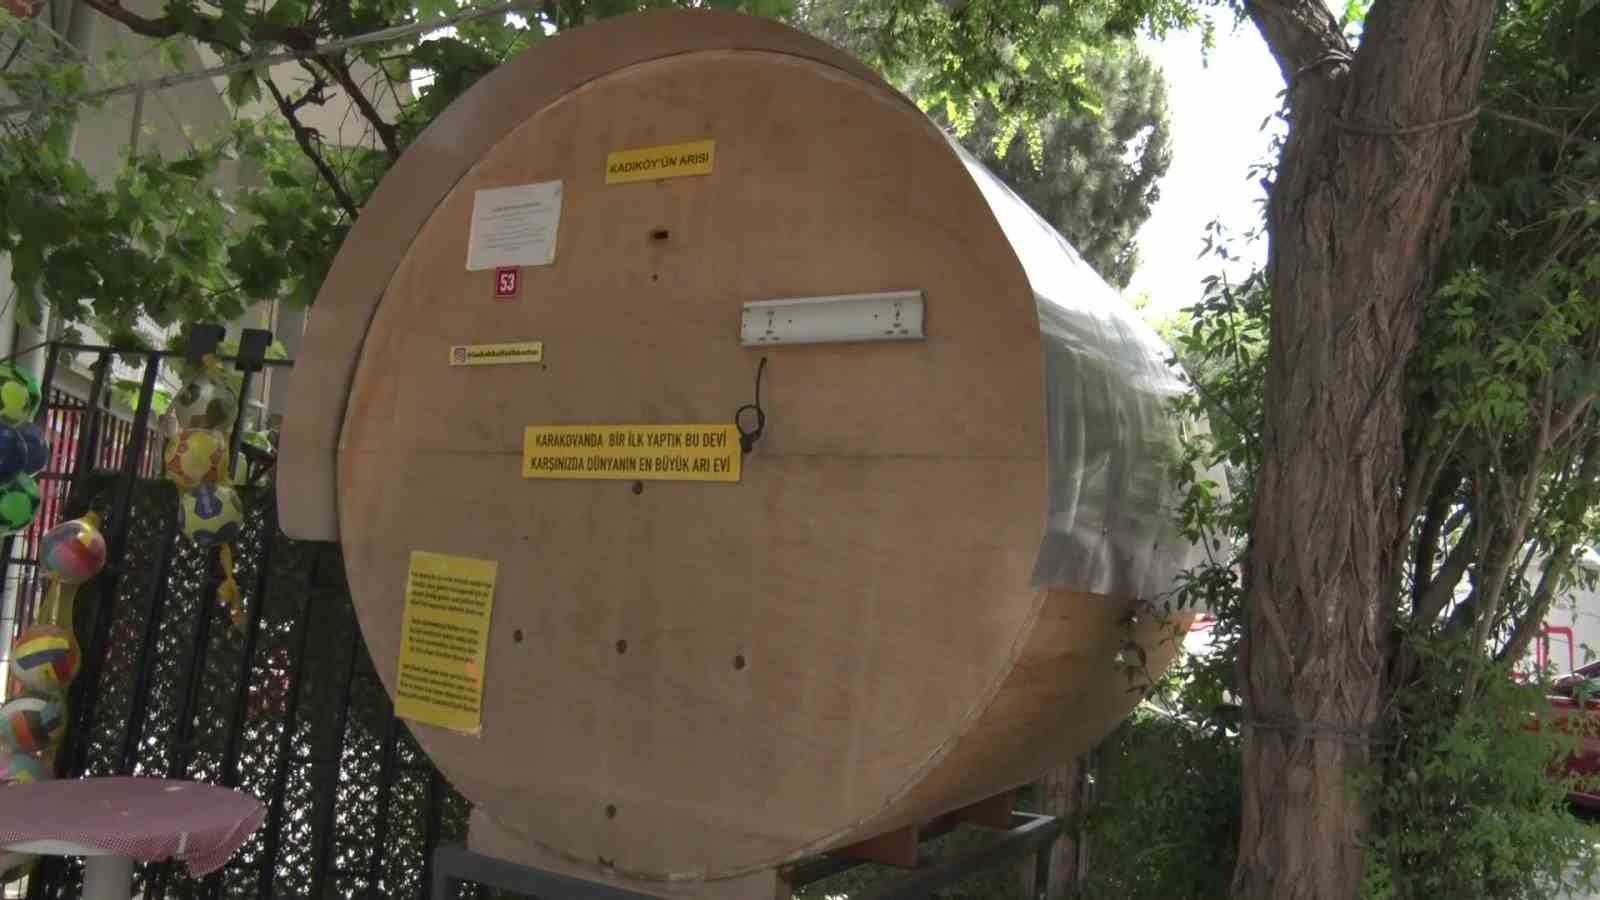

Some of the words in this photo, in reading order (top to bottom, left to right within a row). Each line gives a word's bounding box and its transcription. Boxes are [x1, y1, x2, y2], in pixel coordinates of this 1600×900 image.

[680, 152, 710, 167] ARISI
[500, 273, 515, 291] 53
[535, 432, 603, 447] KARAKOVANDA
[608, 430, 625, 447] BİR
[628, 430, 644, 447] İLK
[647, 432, 681, 447] YAPTIK
[685, 432, 699, 447] BU
[702, 430, 727, 447] DEVİ
[530, 456, 583, 473] KARŞINIZDA
[587, 455, 636, 471] DÜNYANIN
[640, 457, 652, 472] EN
[655, 455, 689, 472] BÜYÜK
[692, 457, 709, 472] ARI
[713, 456, 730, 472] EVİ
